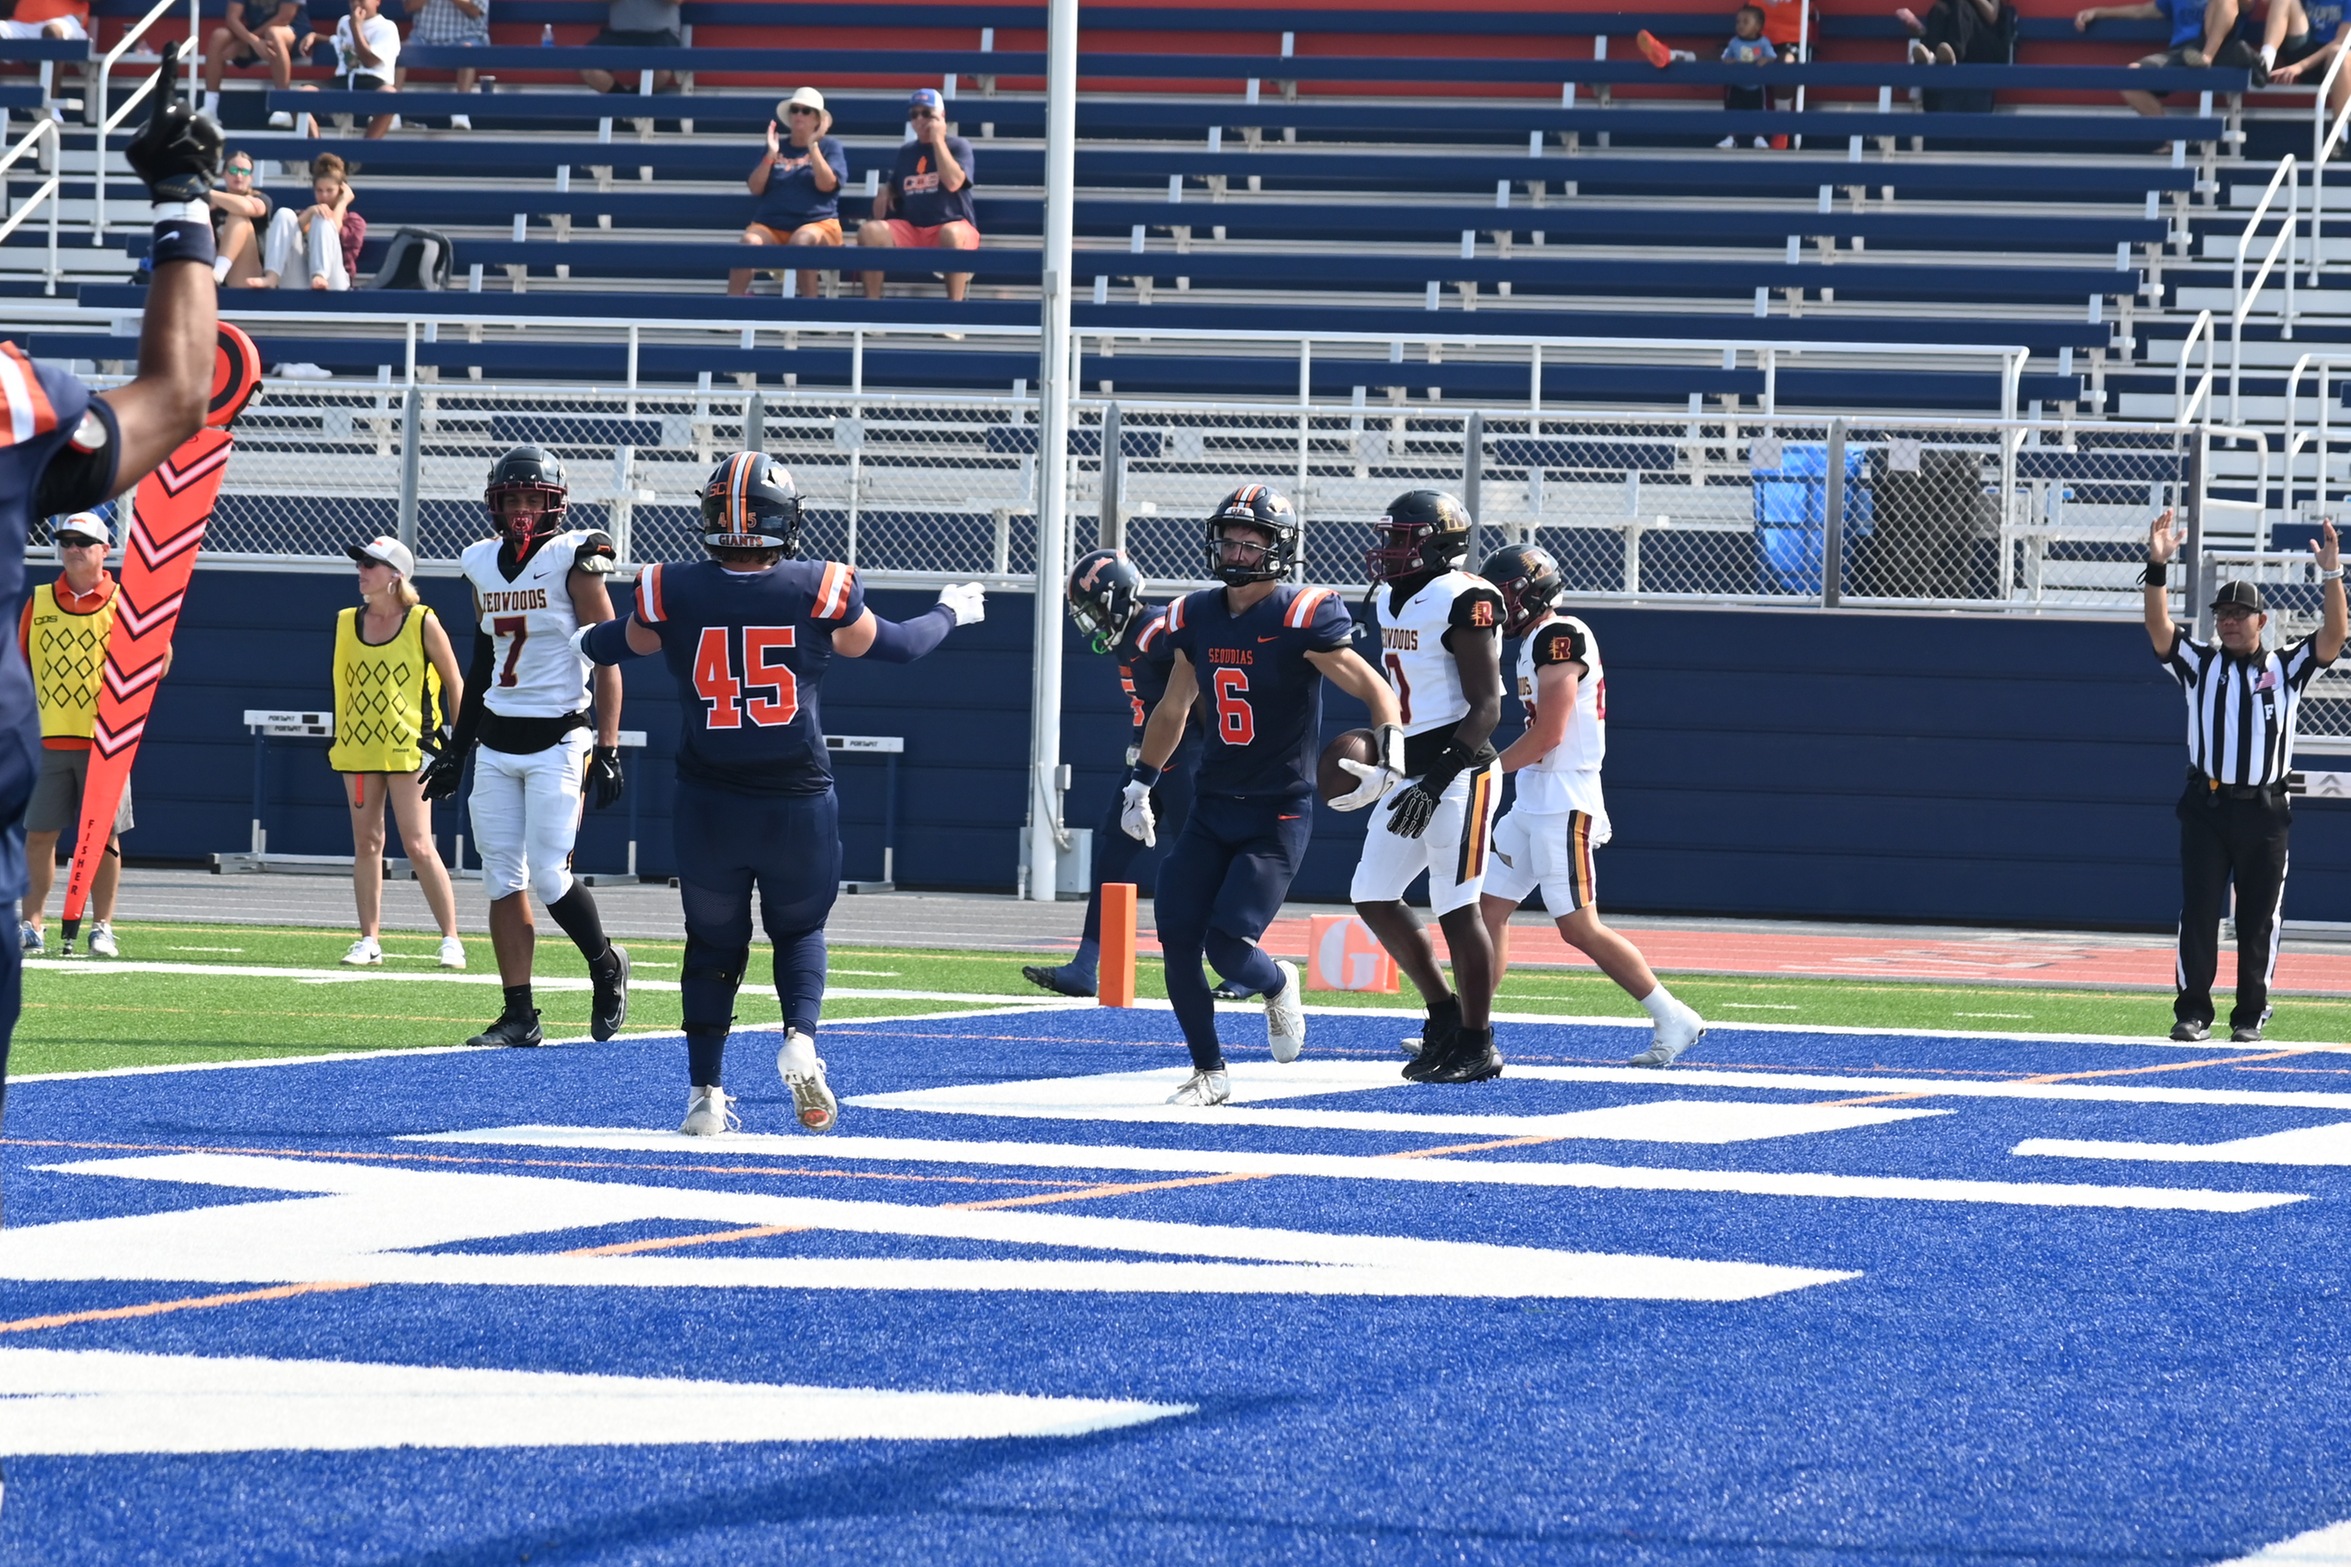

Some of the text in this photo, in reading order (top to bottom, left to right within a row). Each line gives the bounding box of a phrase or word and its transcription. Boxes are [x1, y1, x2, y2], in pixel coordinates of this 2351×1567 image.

[718, 535, 764, 547] GIANTS
[33, 615, 58, 626] COS
[1471, 600, 1494, 627] R
[493, 614, 528, 688] 7
[1208, 648, 1254, 665] SEQUOIAS
[1549, 636, 1572, 661] R
[692, 625, 799, 730] 45
[1212, 666, 1256, 746] 6
[2264, 703, 2275, 721] F
[70, 818, 95, 896] FISHER
[1318, 917, 1380, 990] G
